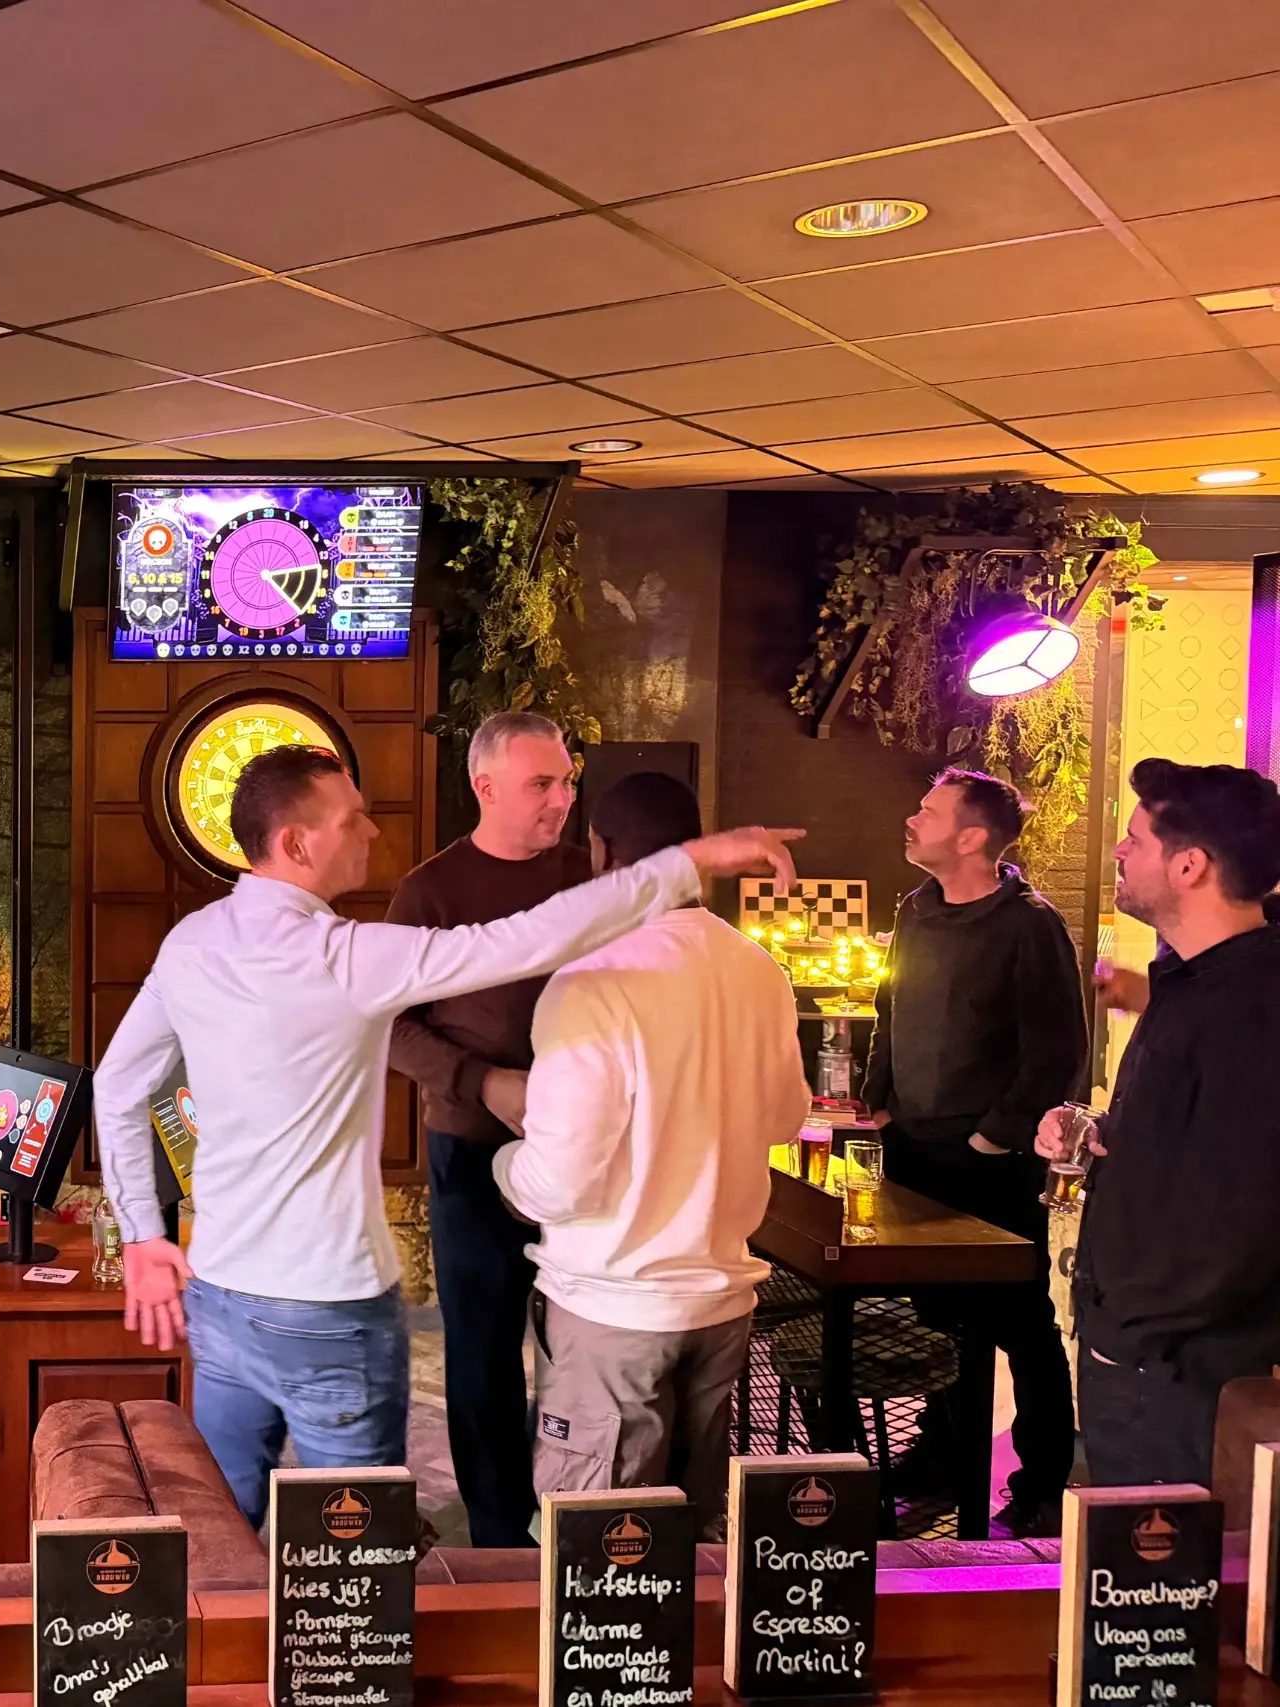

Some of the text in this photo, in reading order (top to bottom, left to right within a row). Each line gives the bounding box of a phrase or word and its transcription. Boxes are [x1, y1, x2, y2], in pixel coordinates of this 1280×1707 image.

[238, 646, 249, 654] X2
[282, 1542, 342, 1567] Welk
[754, 1536, 870, 1571] Pornstar-
[283, 1574, 330, 1600] kies
[786, 1578, 823, 1611] of
[1091, 1568, 1218, 1611] Borrelhapje?
[44, 1610, 133, 1646] Broodje
[562, 1610, 642, 1641] Warme
[1153, 1628, 1187, 1643] ons
[292, 1650, 348, 1667] Dubai
[564, 1645, 670, 1670] Chocolade
[756, 1641, 866, 1678] Martini?
[1114, 1648, 1196, 1677] personeel
[54, 1659, 110, 1694] Oma's
[1089, 1682, 1141, 1700] naar
